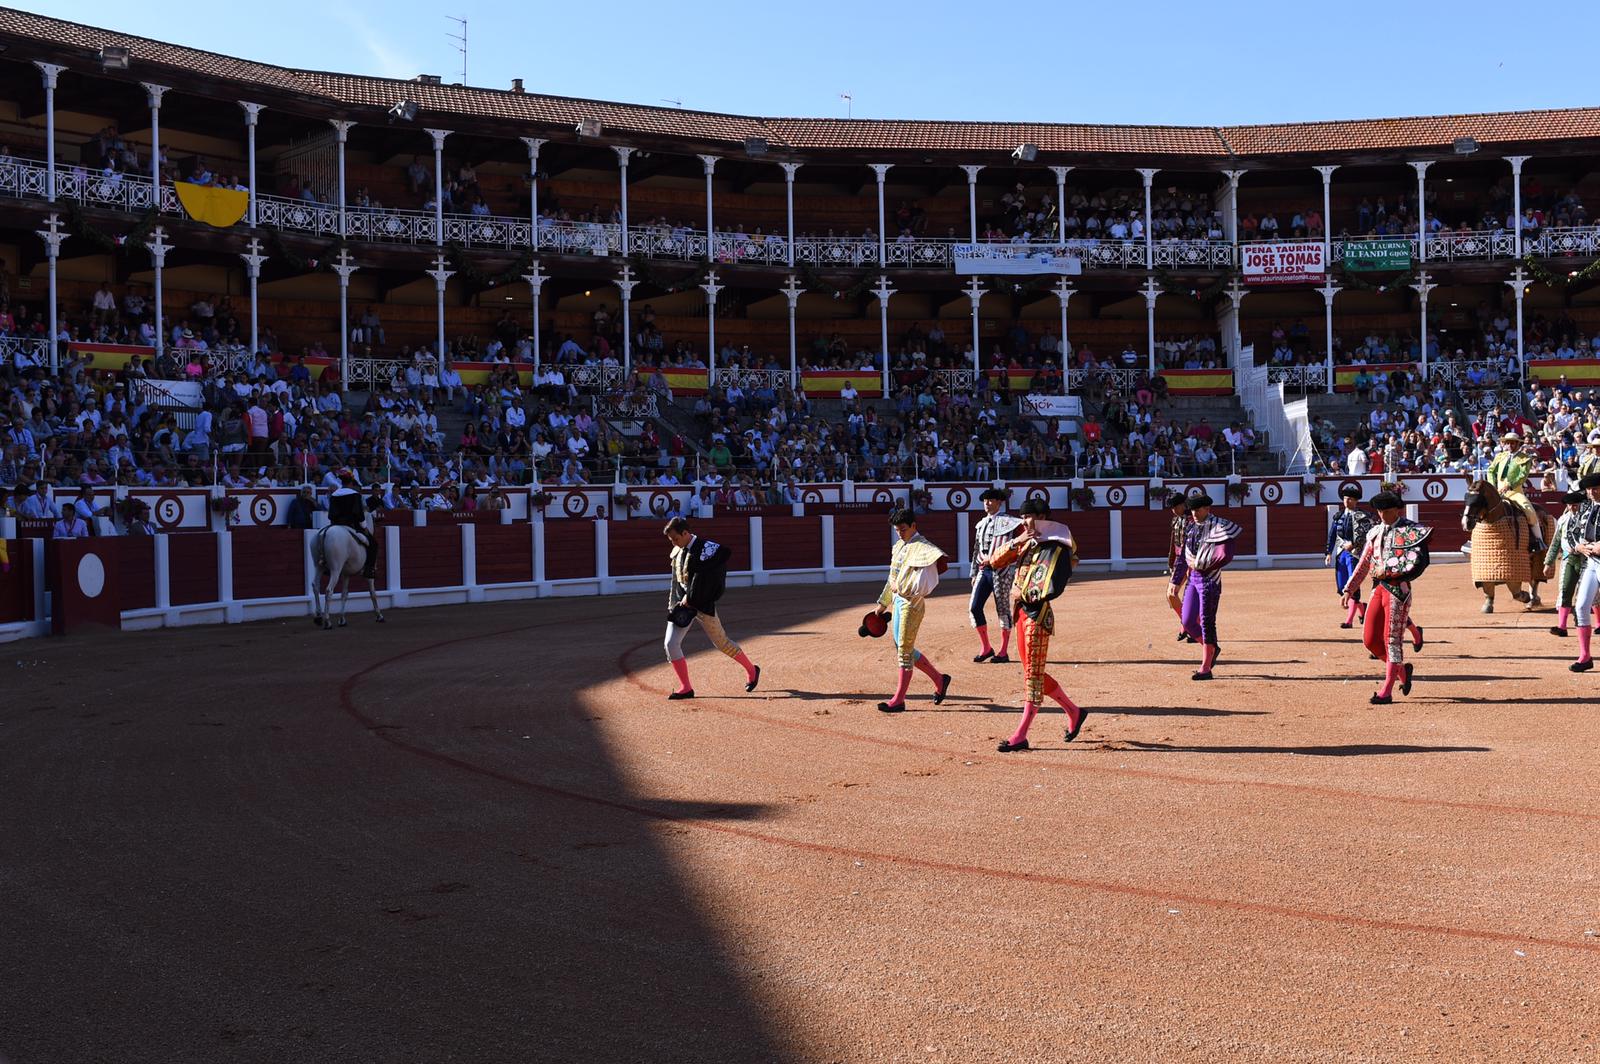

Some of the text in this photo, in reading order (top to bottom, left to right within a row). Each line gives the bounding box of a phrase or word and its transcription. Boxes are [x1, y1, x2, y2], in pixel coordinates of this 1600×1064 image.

[1276, 245, 1322, 253] TAURINA
[1371, 242, 1406, 250] TAURINA
[1345, 250, 1357, 258] EL
[1360, 250, 1388, 258] FANDI
[1247, 253, 1321, 267] JOSE TOMAS
[1263, 265, 1305, 274] GIJON
[1268, 489, 1274, 497] 9
[1430, 485, 1438, 494] 11
[880, 495, 886, 503] 7
[955, 494, 962, 504] 9
[1113, 491, 1120, 501] 9
[573, 499, 581, 510] 7
[657, 498, 665, 507] 7
[165, 503, 174, 518] 5
[259, 503, 267, 516] 5
